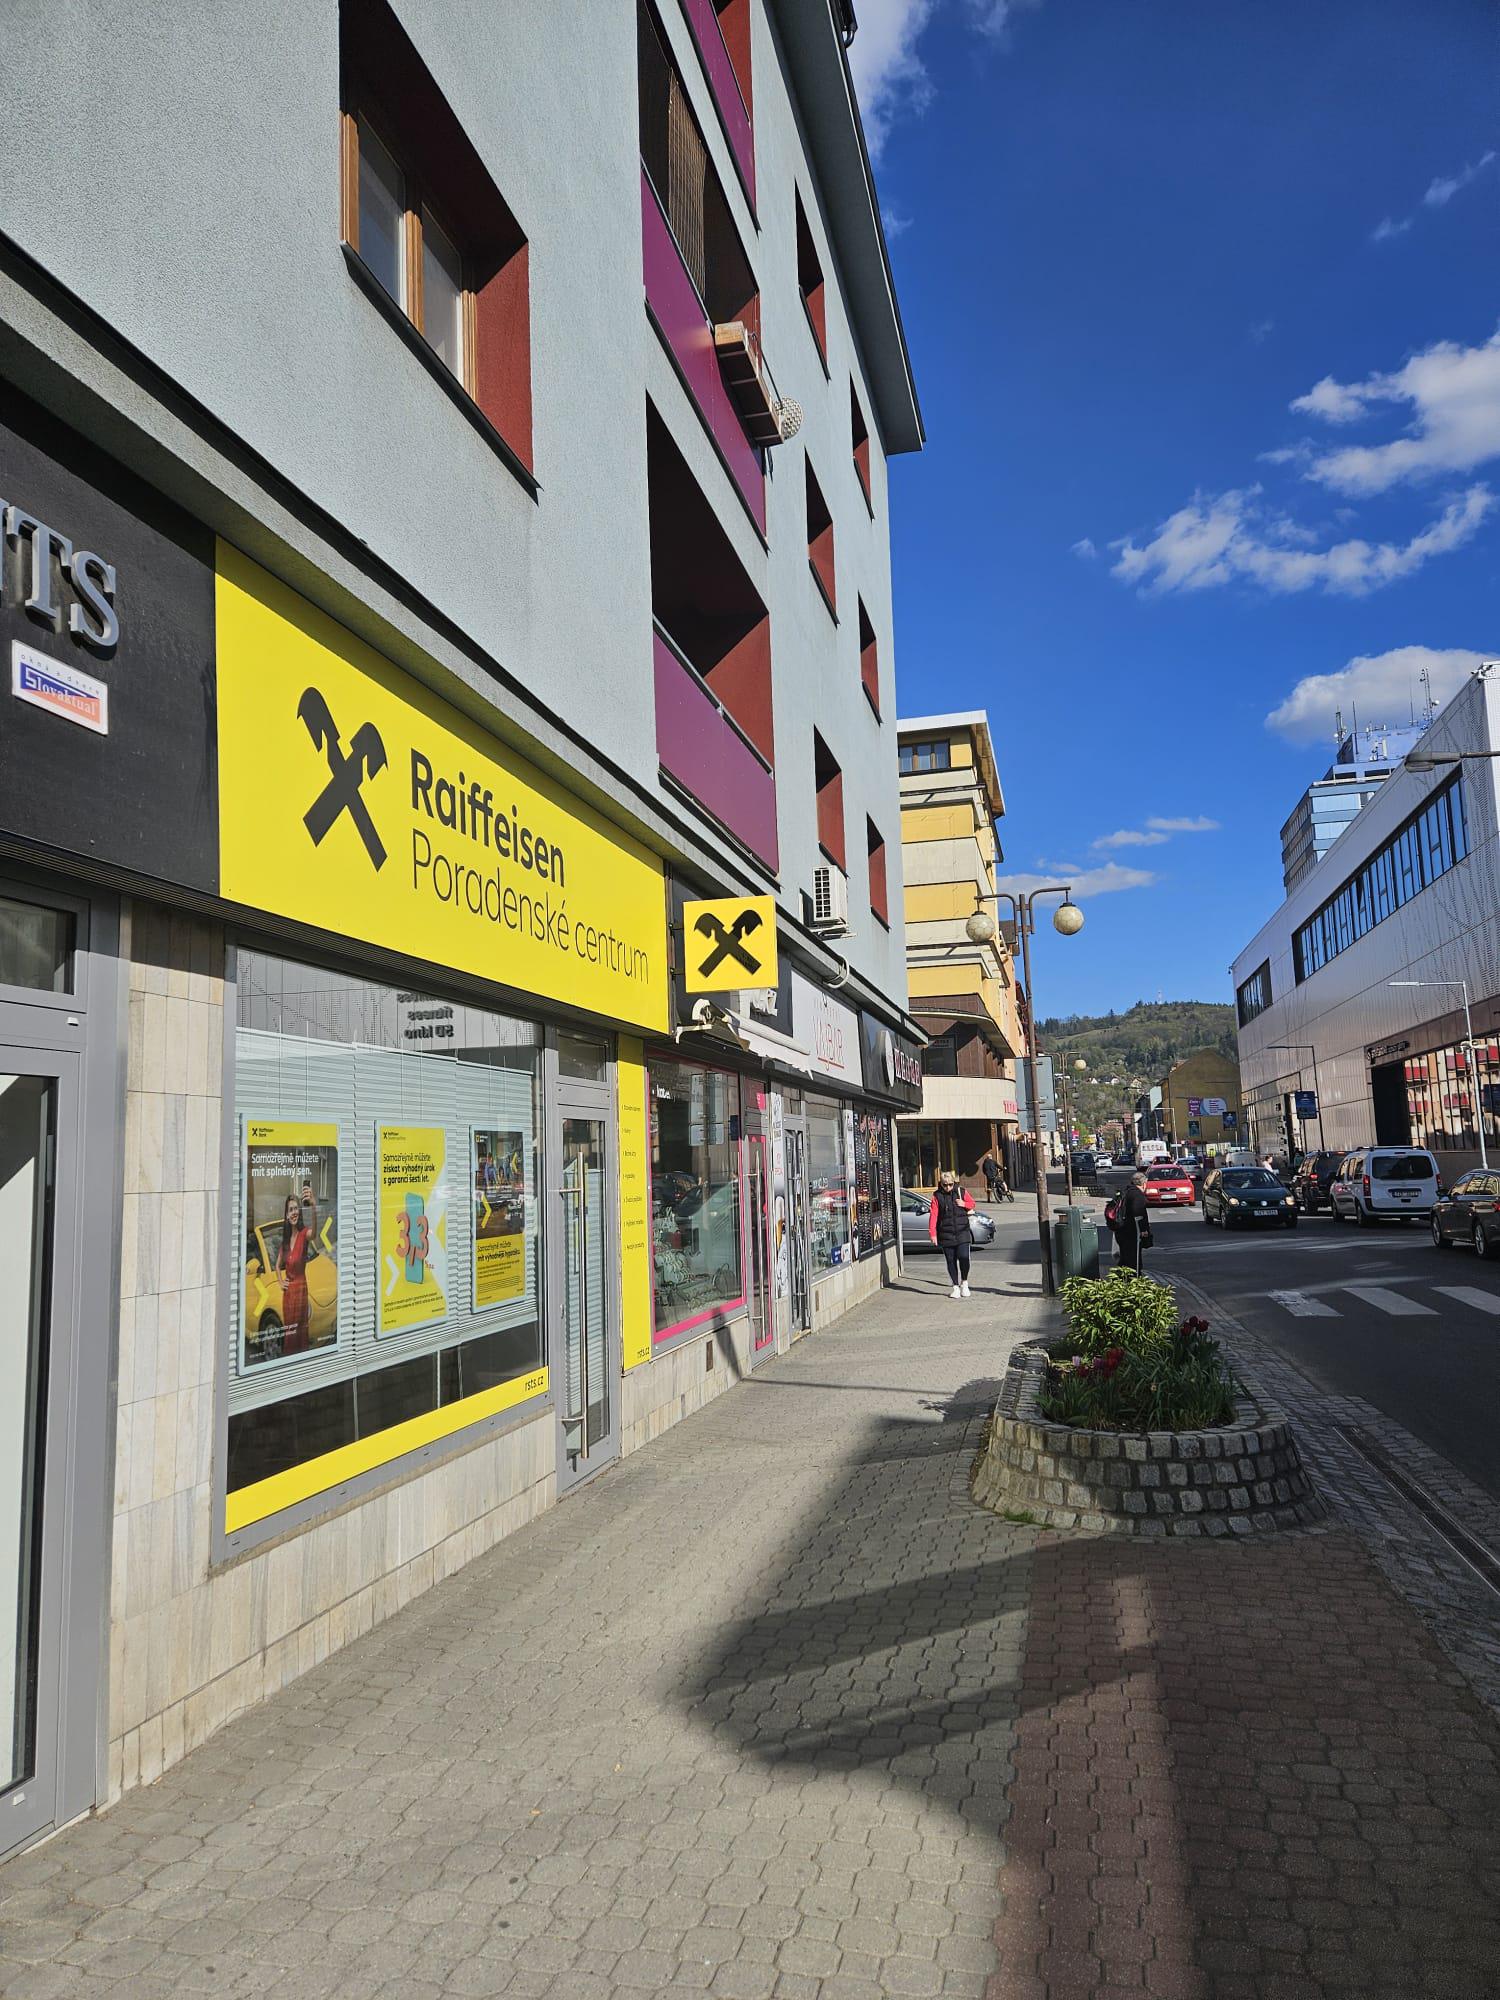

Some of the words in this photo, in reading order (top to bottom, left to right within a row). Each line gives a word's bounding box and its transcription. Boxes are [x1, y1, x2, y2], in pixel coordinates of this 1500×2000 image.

[25, 666, 97, 716] Slovaktual
[411, 748, 565, 888] Raiffeisen
[412, 828, 570, 951] Poradenské
[574, 921, 649, 985] centrum
[251, 1152, 295, 1166] Samozřejmě
[295, 1151, 320, 1163] můžete
[251, 1165, 265, 1177] mít
[266, 1164, 296, 1178] splněný
[296, 1165, 312, 1176] sen.
[394, 1212, 429, 1268] 3,3
[524, 1375, 544, 1392] rsts.cz
